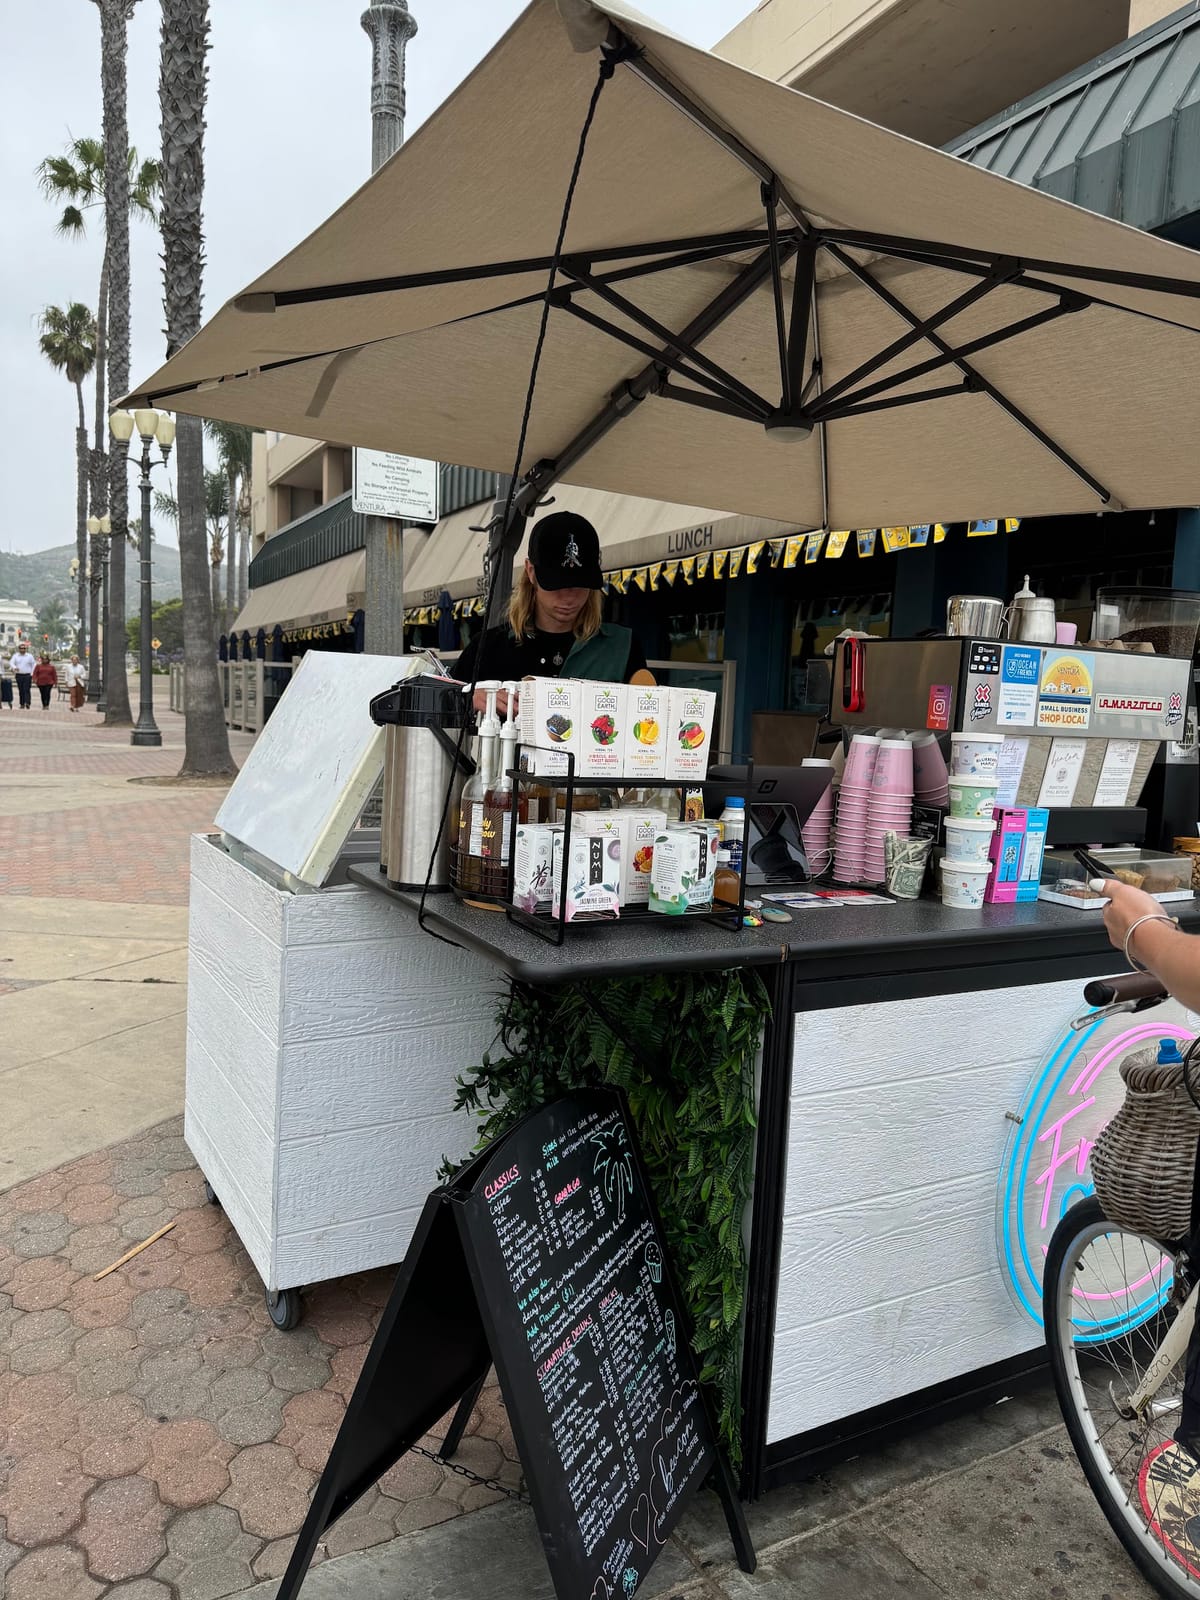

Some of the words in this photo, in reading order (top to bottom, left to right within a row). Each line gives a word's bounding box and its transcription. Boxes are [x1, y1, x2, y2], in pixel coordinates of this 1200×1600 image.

[355, 502, 386, 512] VENTURA
[667, 525, 713, 554] LUNCH
[1017, 660, 1037, 669] OCEAN
[1039, 713, 1061, 724] SHOP
[1062, 714, 1087, 724] LOCAL
[1040, 705, 1060, 713] SMALL
[1061, 706, 1088, 714] BUSINESS
[592, 842, 601, 879] NUMI
[580, 897, 597, 905] JASMINE
[542, 1139, 558, 1159] Sizes
[484, 1164, 519, 1202] CLASSICS
[489, 1194, 511, 1223] Coffee
[492, 1209, 507, 1228] Tea
[496, 1213, 520, 1241] Espresso
[502, 1245, 514, 1259] Hot
[512, 1275, 527, 1293] Cold
[526, 1260, 541, 1277] Brew
[517, 1298, 528, 1311] We
[528, 1287, 540, 1302] also
[526, 1323, 539, 1341] Add
[536, 1336, 573, 1381] SIGNATURE
